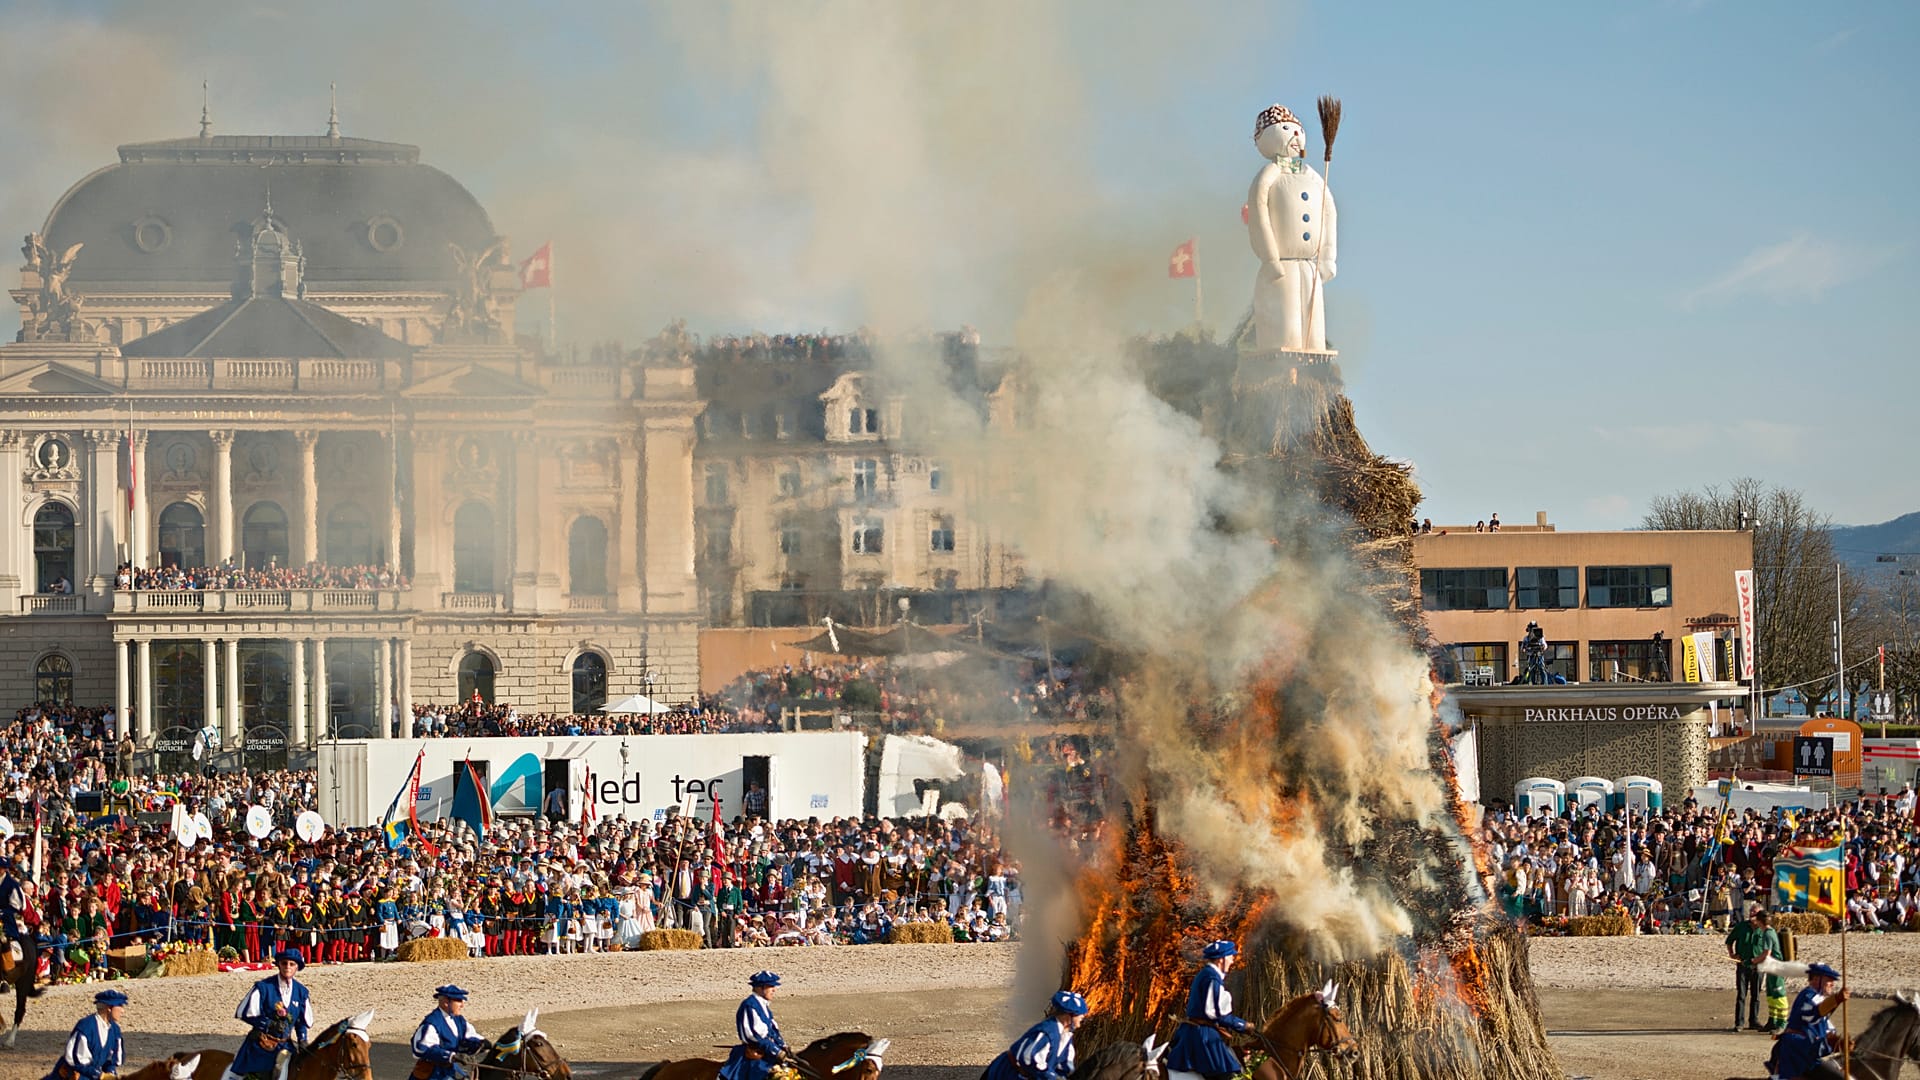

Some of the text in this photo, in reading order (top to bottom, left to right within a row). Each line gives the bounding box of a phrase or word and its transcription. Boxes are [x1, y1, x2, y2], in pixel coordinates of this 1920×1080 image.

[1685, 615, 1740, 624] restaurant
[1524, 704, 1681, 722] PARKHAUS OPÉRA
[1795, 767, 1831, 775] TOILETTEN
[670, 774, 724, 804] tec
